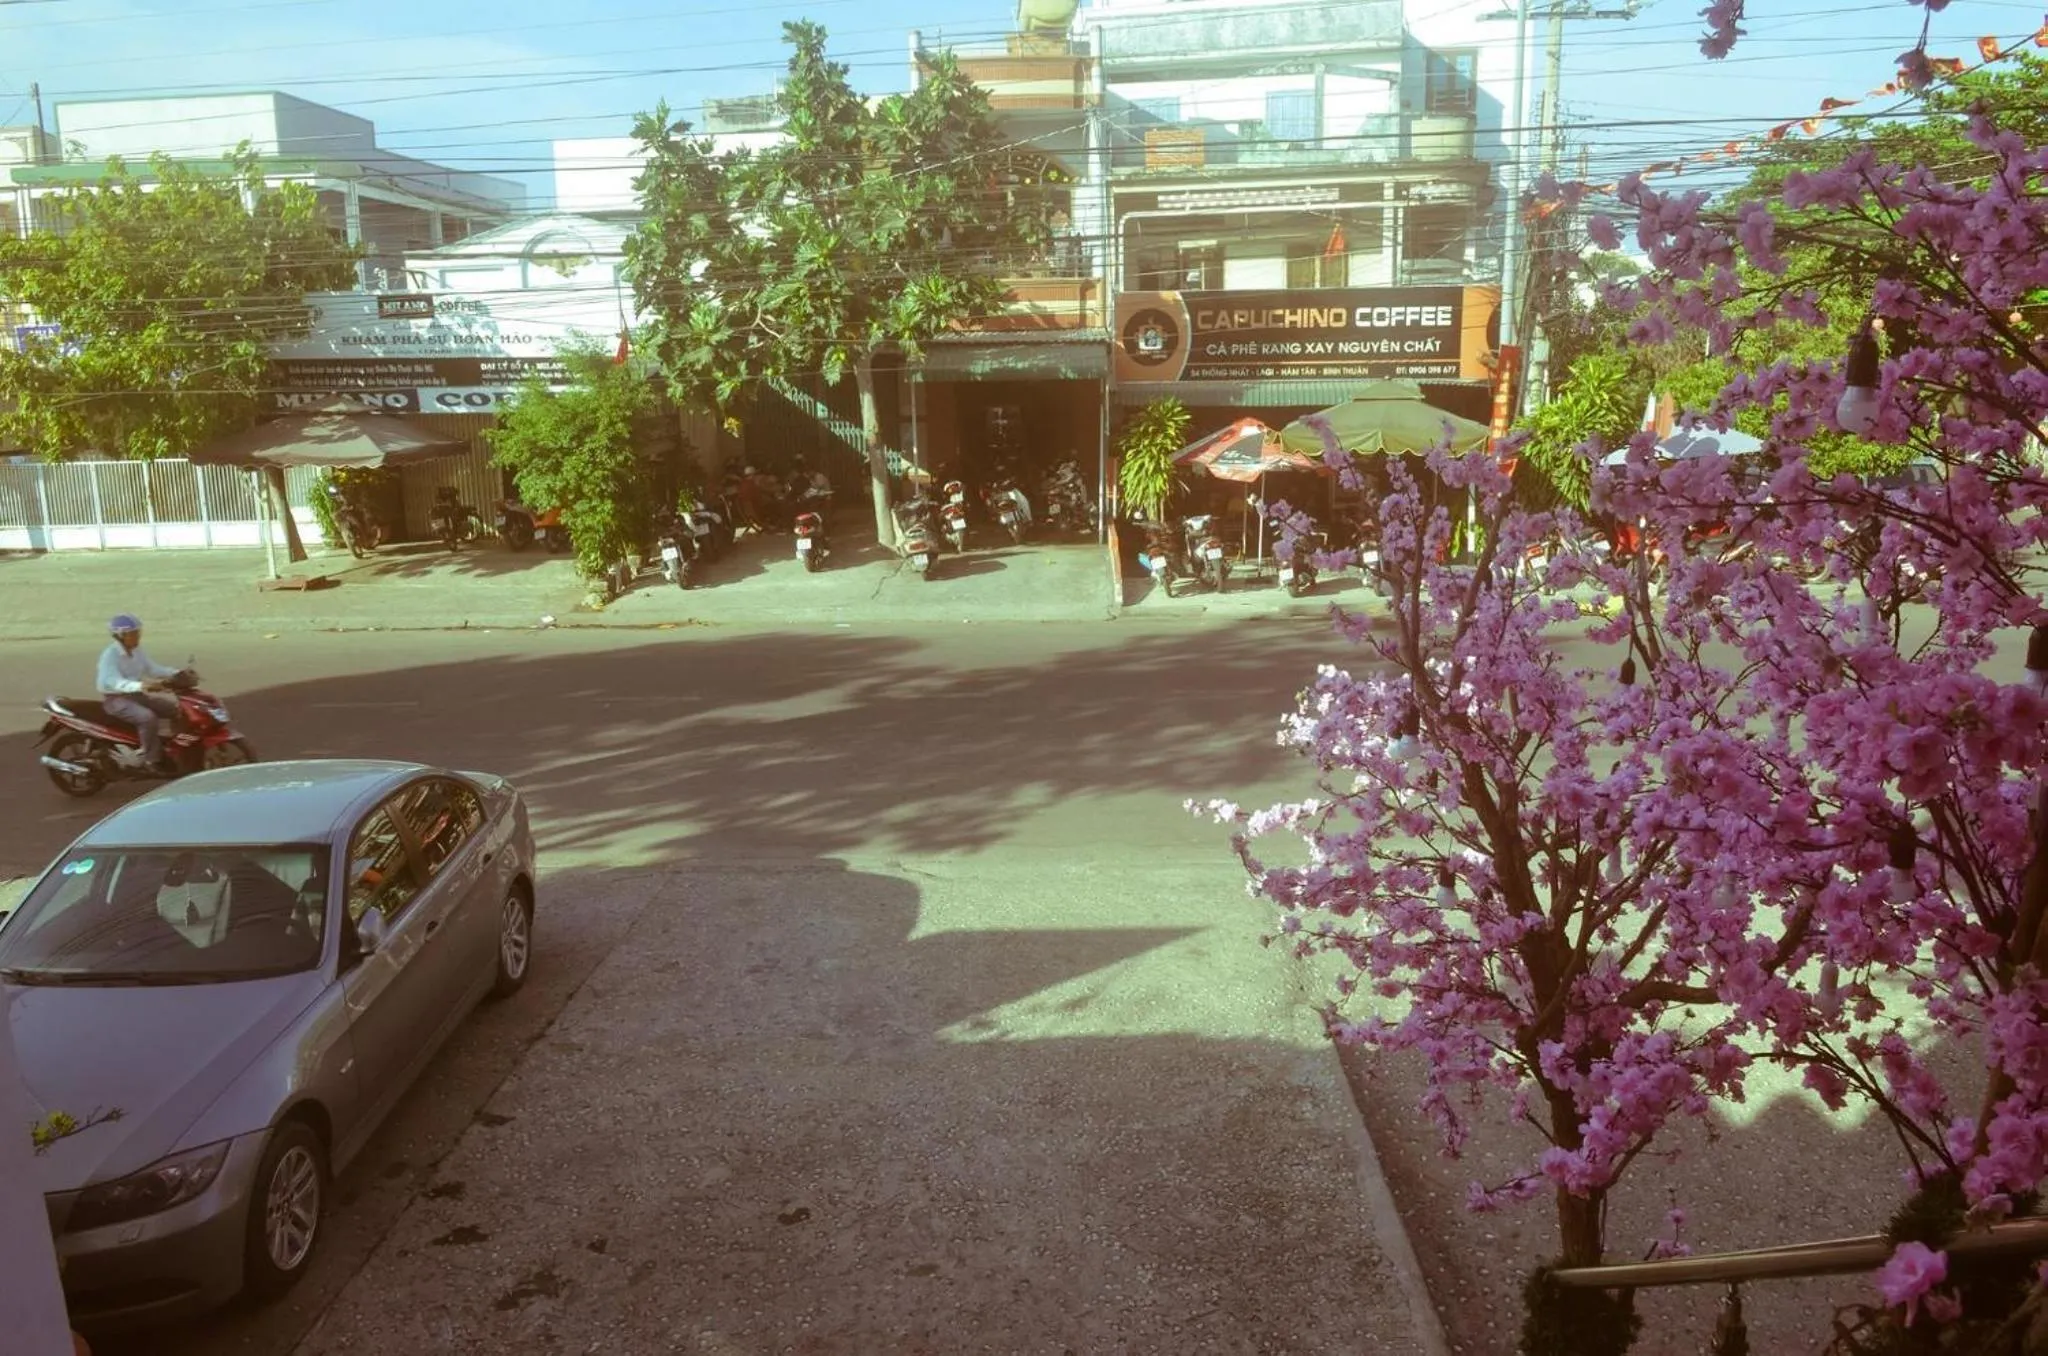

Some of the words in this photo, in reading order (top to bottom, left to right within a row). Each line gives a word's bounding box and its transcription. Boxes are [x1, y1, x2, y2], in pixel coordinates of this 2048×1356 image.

[439, 301, 482, 312] COFFEE
[1197, 308, 1347, 329] CAPUCHINO
[1355, 306, 1452, 326] COFFEE
[1206, 341, 1228, 356] CÀ
[1231, 340, 1257, 355] PHÊ
[1262, 344, 1302, 355] RANG
[1305, 341, 1335, 354] XAY
[1338, 338, 1400, 354] NGUYÊN
[1403, 336, 1442, 353] CHẤT
